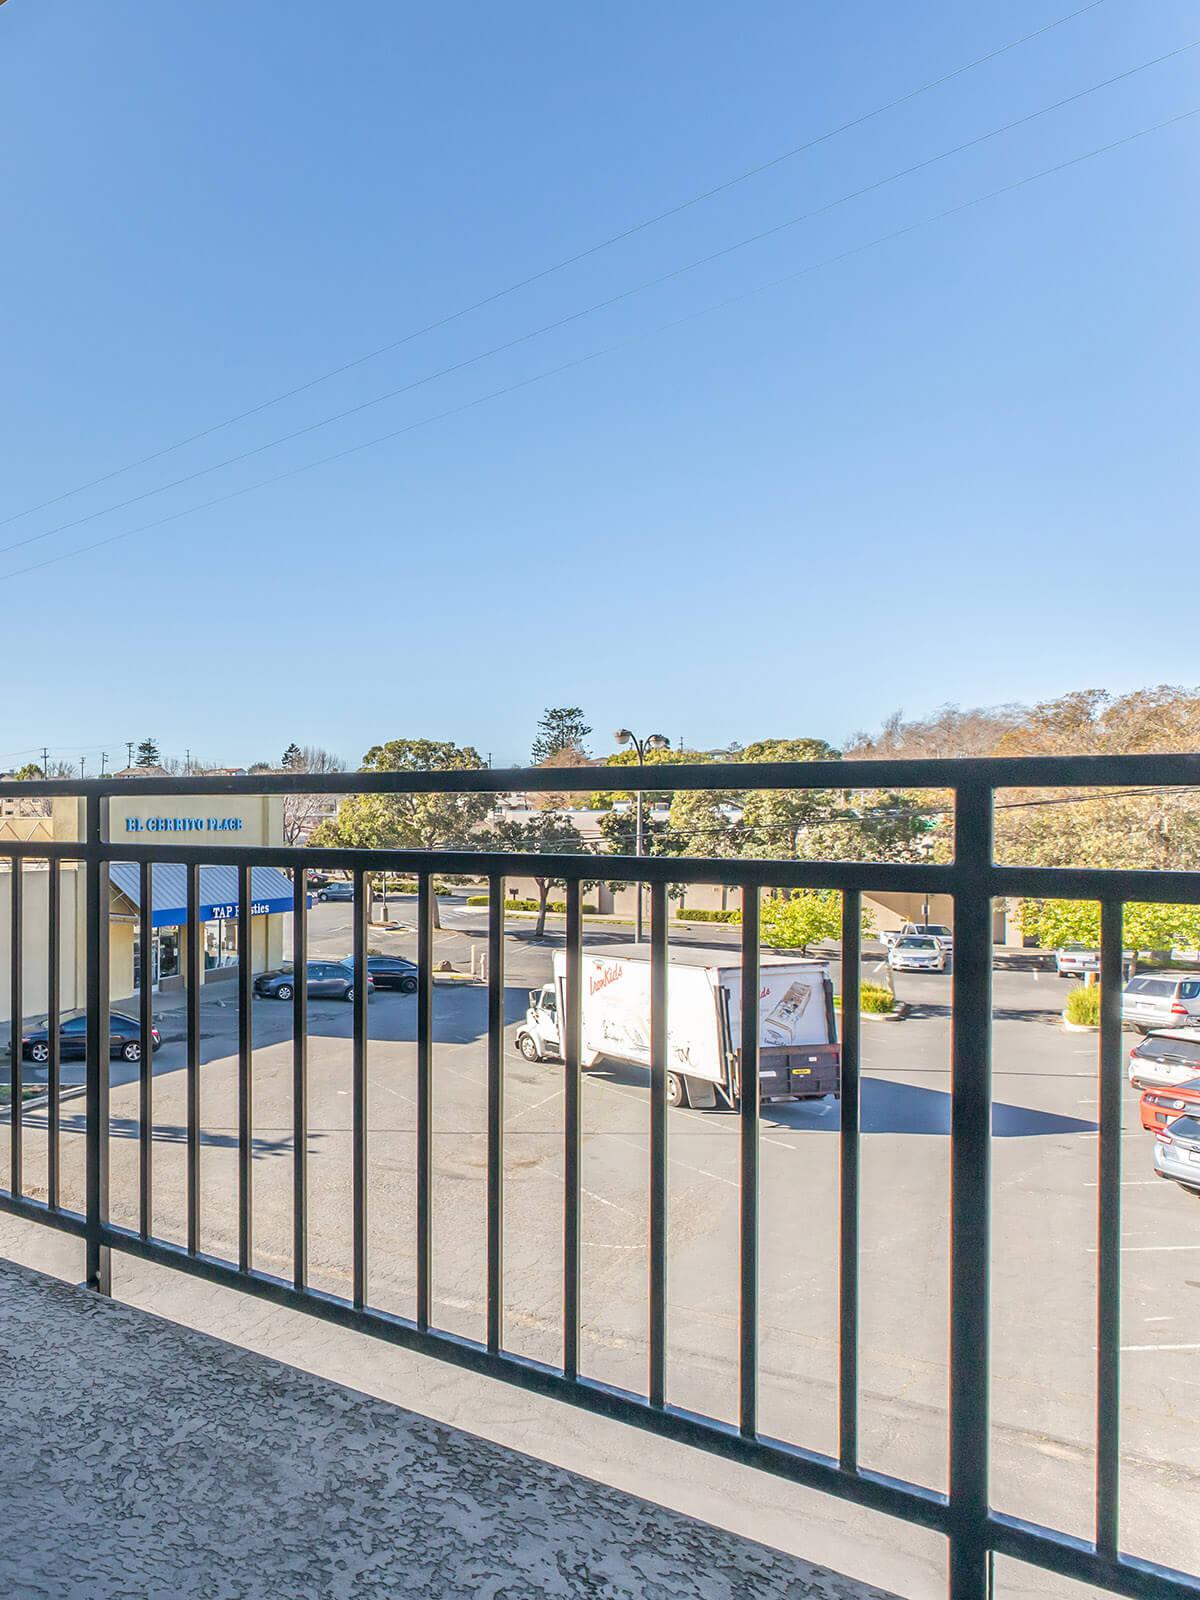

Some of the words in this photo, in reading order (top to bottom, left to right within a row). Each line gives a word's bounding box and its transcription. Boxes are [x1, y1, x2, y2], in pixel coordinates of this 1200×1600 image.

[126, 818, 144, 831] EL
[146, 817, 204, 831] CERRITO
[207, 818, 243, 831] PLACE
[213, 906, 233, 919] TAP
